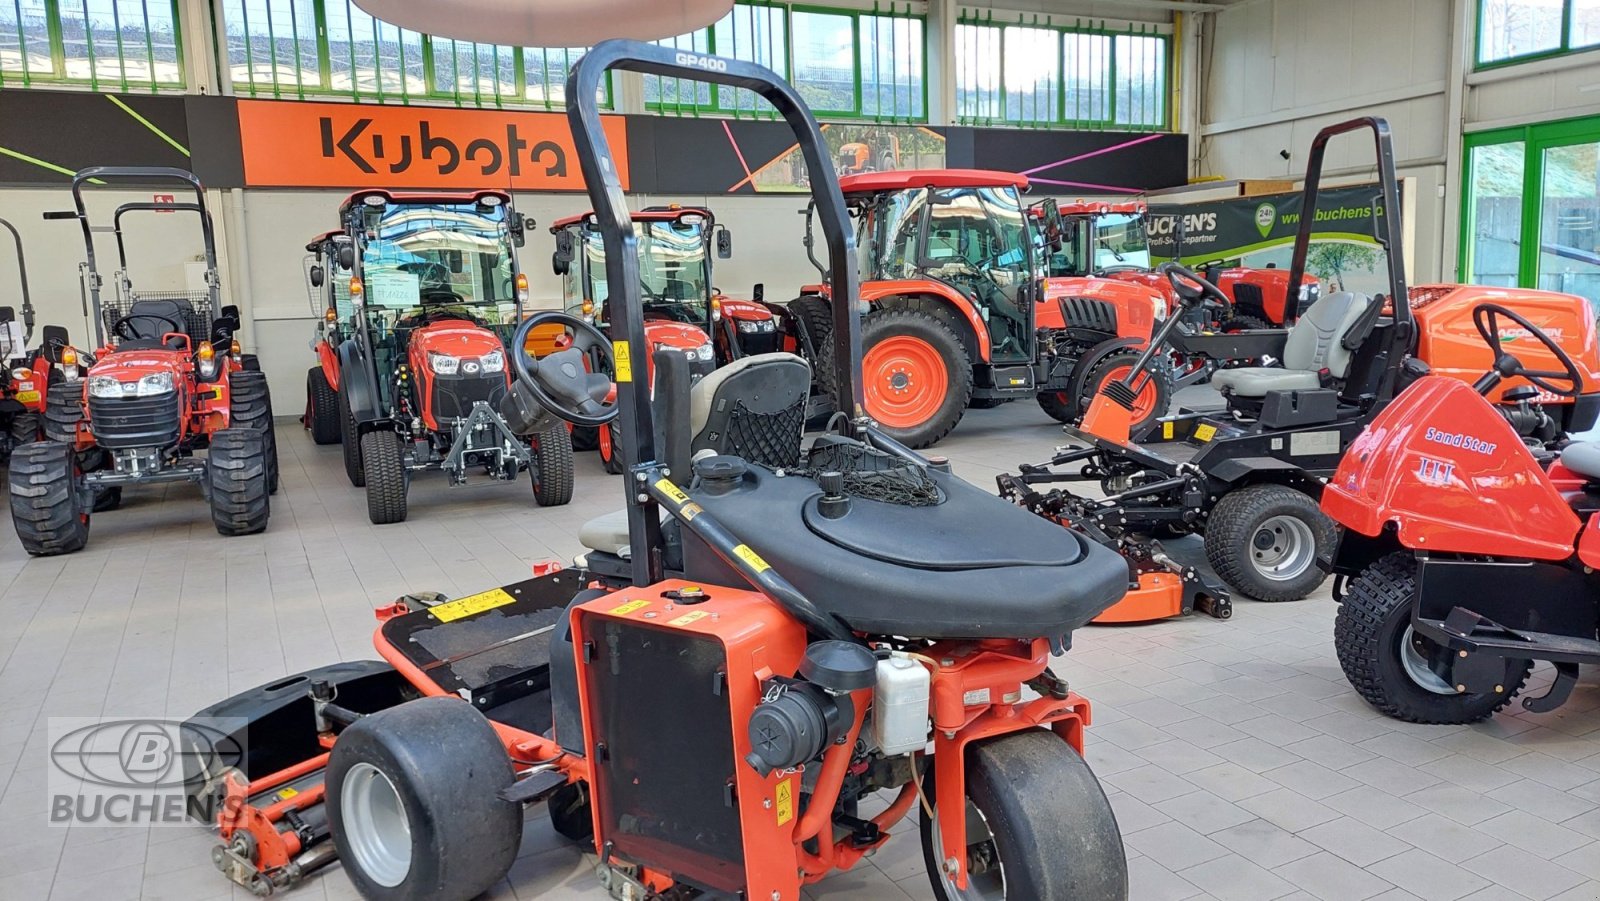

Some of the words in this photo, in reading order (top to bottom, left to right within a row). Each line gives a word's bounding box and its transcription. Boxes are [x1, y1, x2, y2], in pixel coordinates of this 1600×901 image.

[675, 52, 727, 72] GP400
[319, 117, 567, 177] Kubota
[1146, 212, 1217, 236] UCHEN'S
[1420, 457, 1456, 484] III
